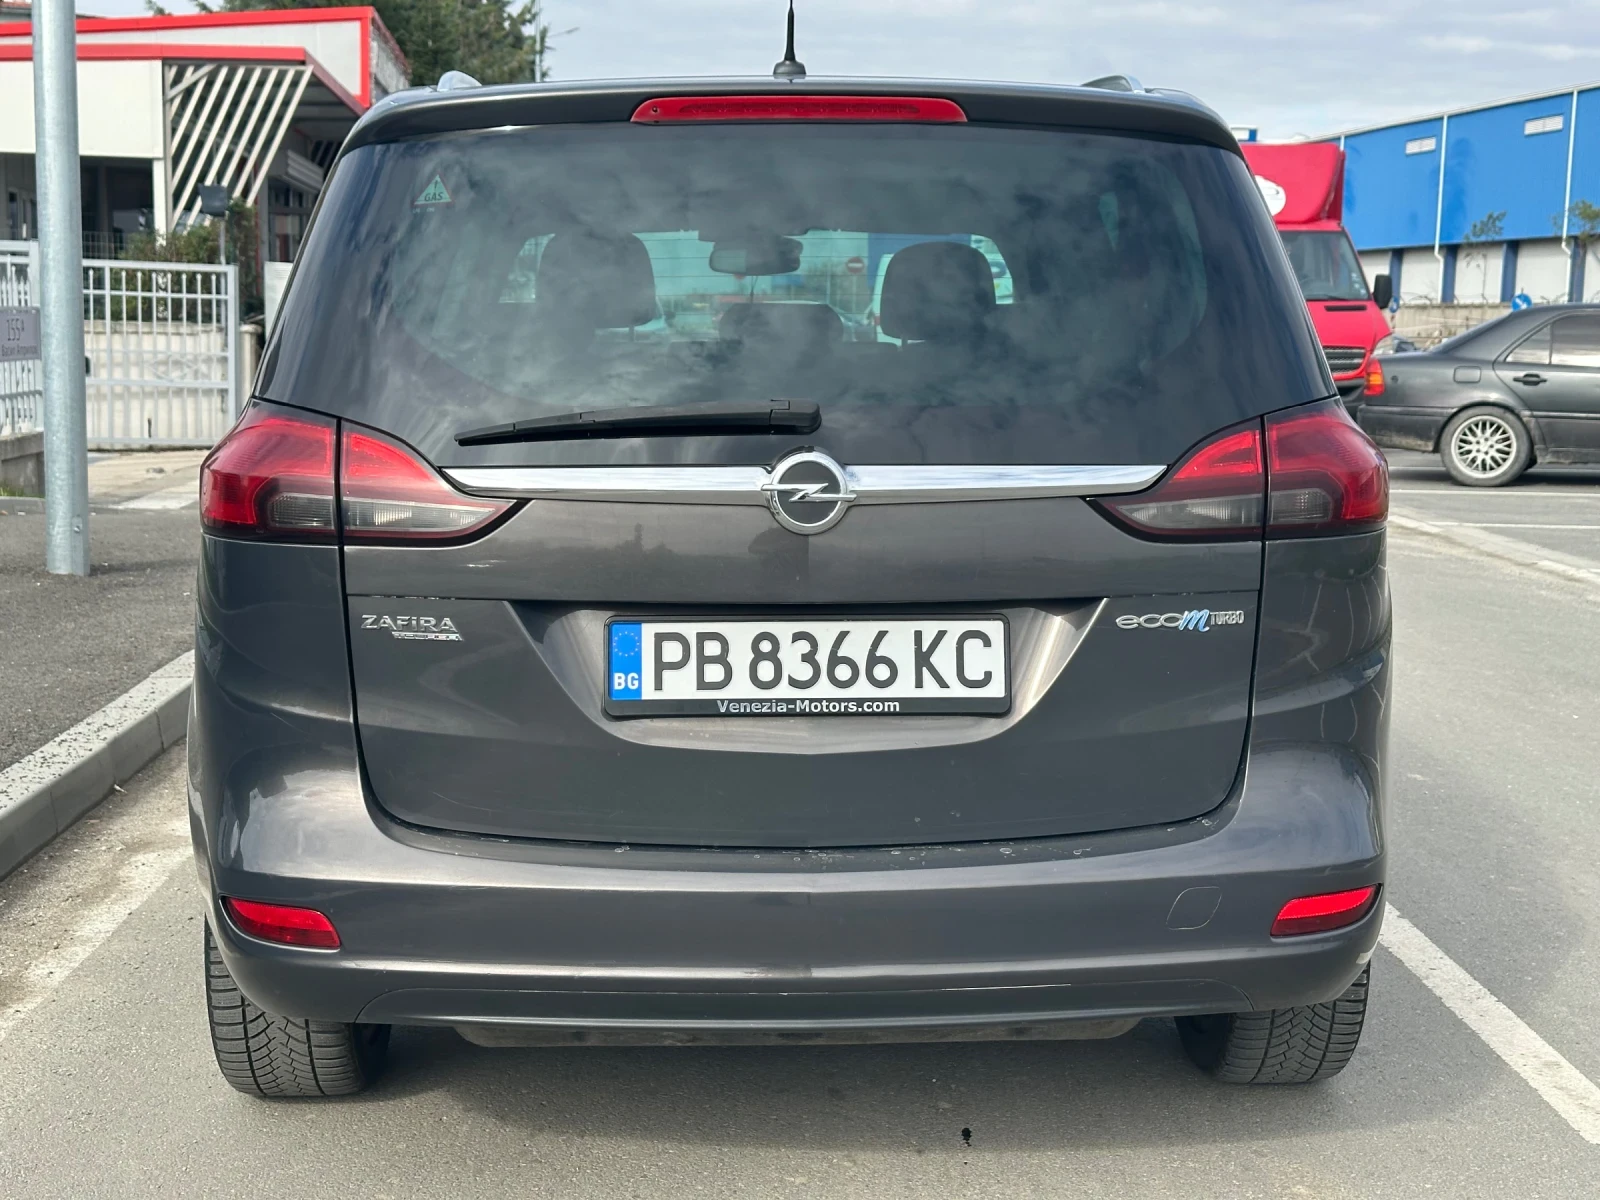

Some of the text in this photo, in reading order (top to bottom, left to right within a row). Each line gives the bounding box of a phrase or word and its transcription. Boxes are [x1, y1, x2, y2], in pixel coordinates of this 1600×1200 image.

[424, 192, 444, 202] GAS
[361, 614, 458, 632] ZAFIRA
[1210, 610, 1245, 625] TURBO
[653, 629, 993, 691] PB 8366 KC
[613, 672, 640, 691] BG
[717, 699, 901, 714] Venezia-Motors.com
